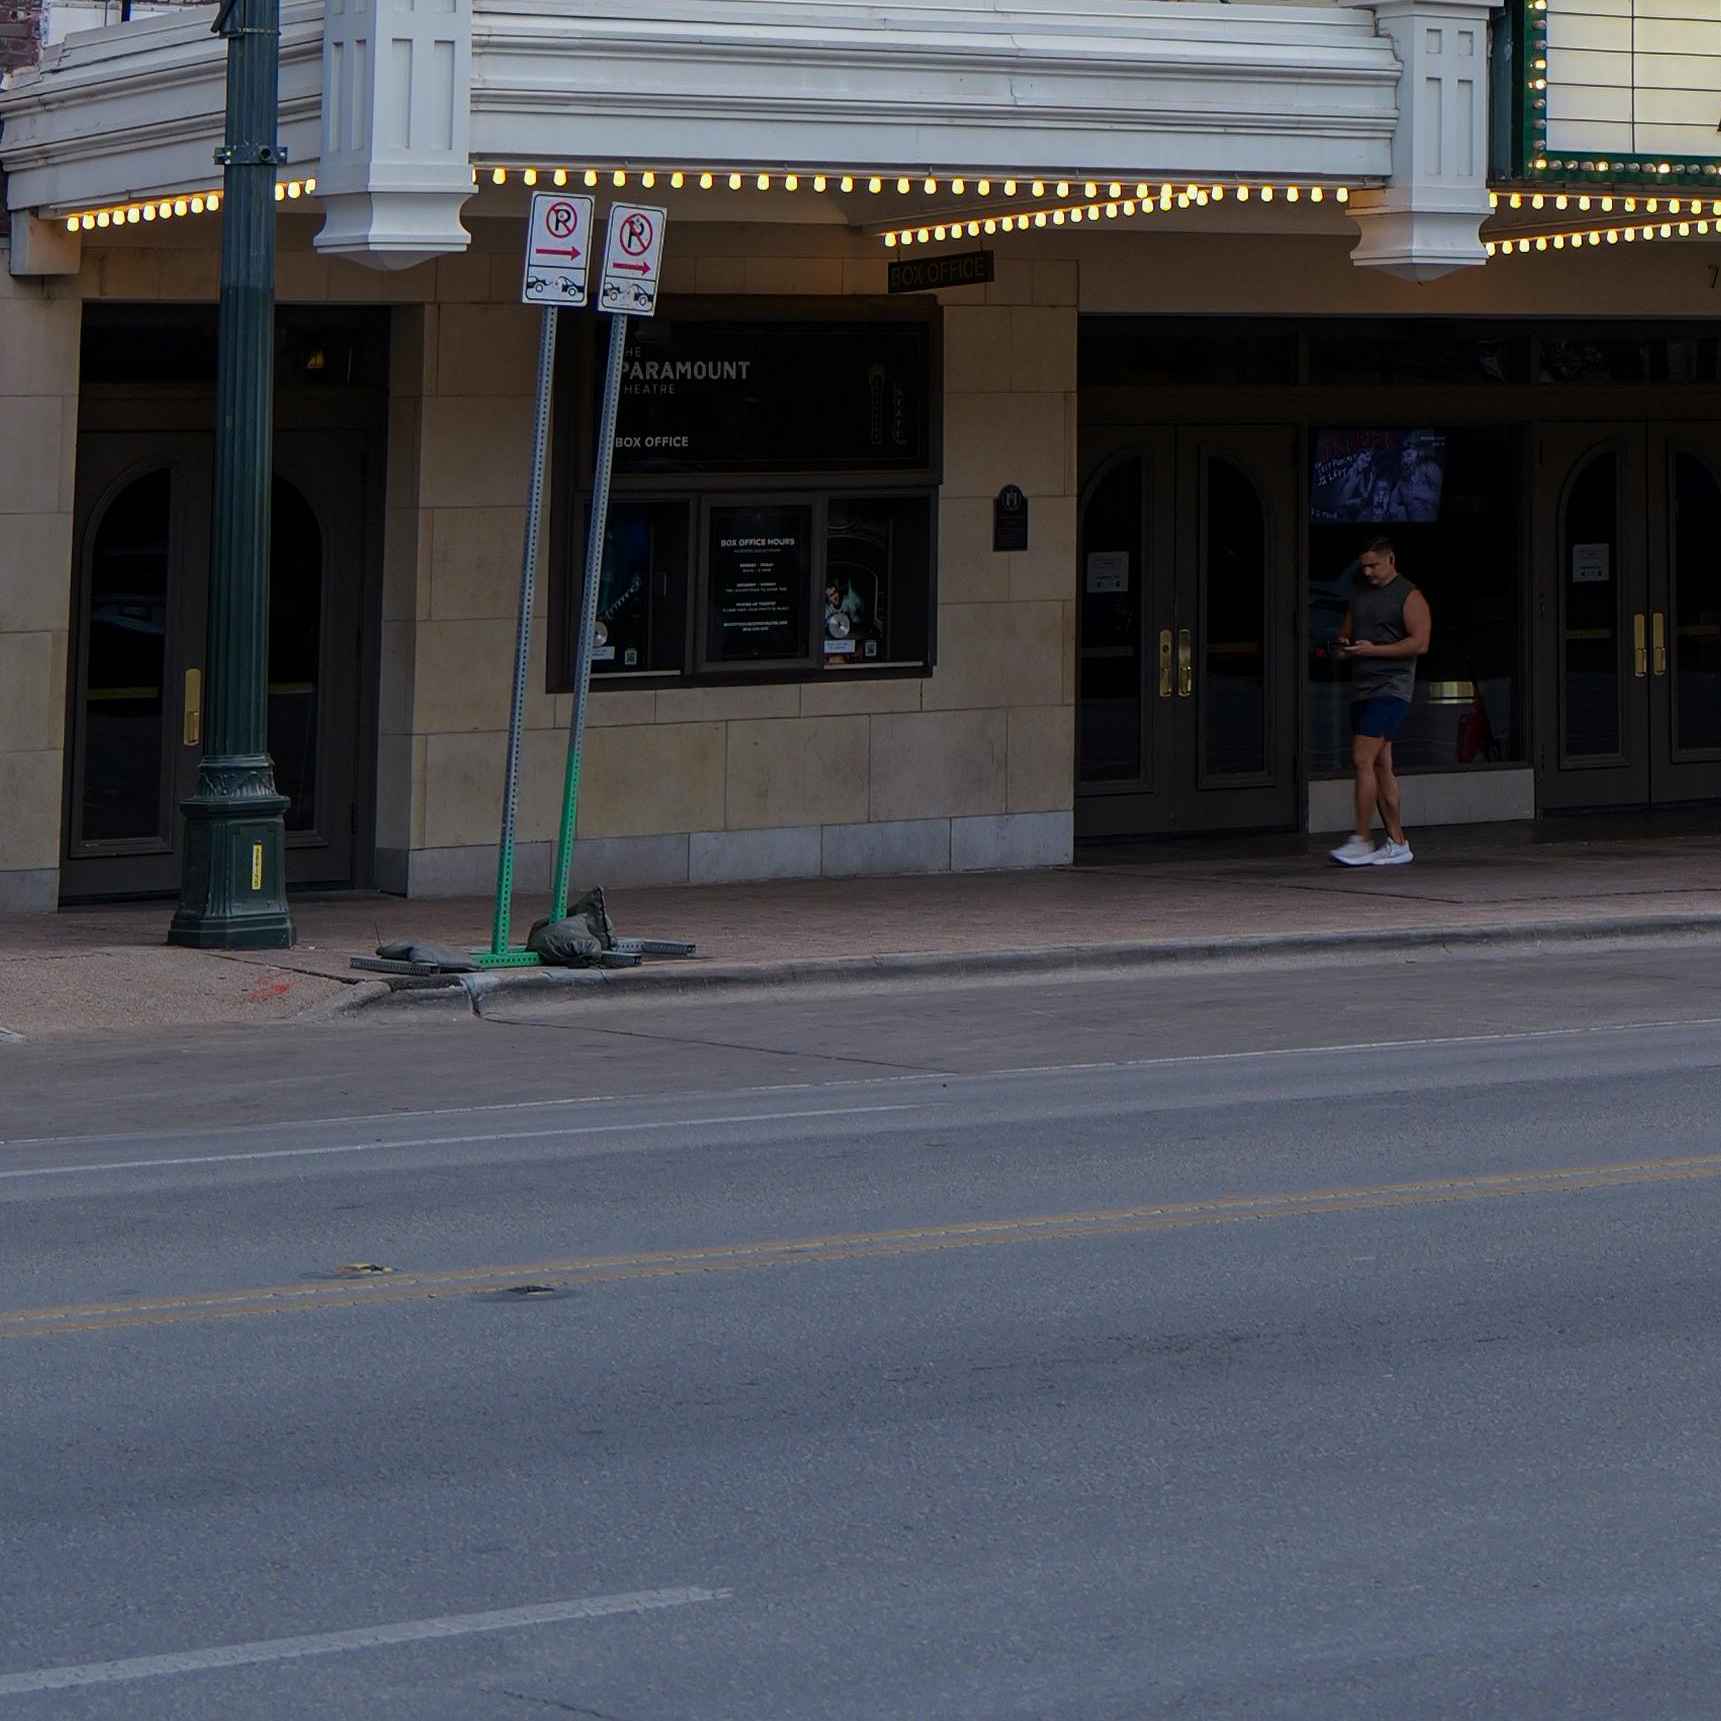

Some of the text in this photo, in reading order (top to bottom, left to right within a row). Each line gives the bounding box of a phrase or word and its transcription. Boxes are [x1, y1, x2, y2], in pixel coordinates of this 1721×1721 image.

[891, 256, 985, 288] BOX OFFICE
[624, 346, 642, 358] HE
[622, 383, 676, 395] HEATRE
[615, 435, 689, 448] BOX OFFICE
[720, 538, 795, 548] BOX OFFICE HOURS
